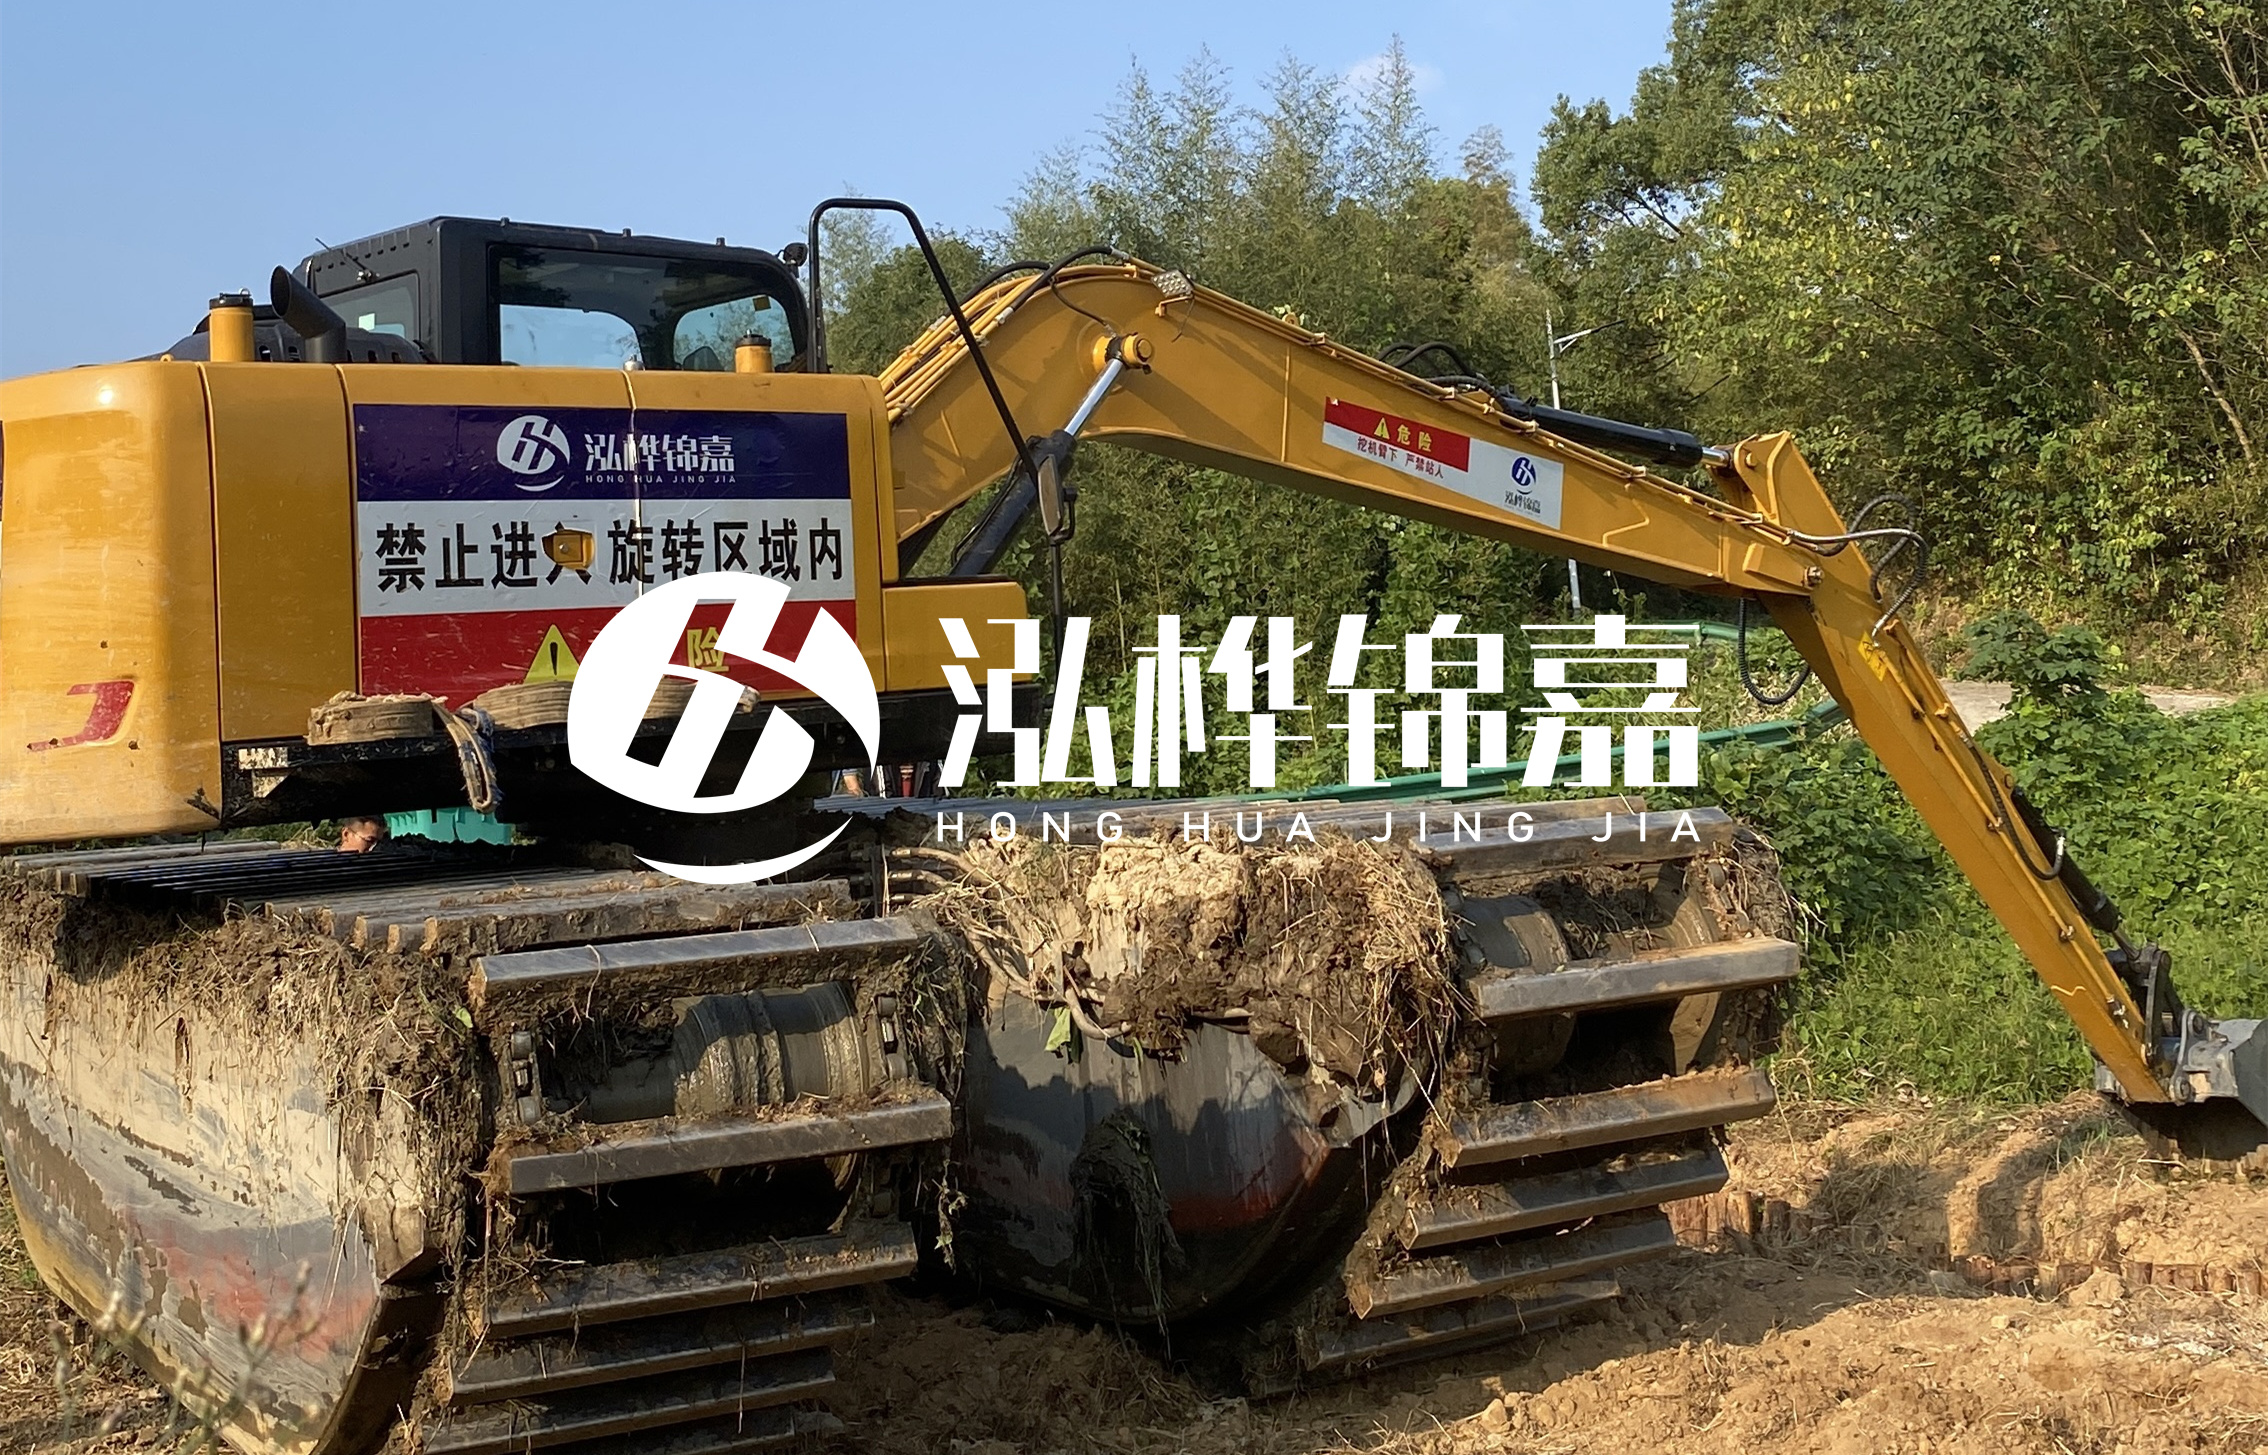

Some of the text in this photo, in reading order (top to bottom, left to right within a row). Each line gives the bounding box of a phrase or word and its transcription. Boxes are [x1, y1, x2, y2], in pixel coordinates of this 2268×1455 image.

[1397, 424, 1432, 452] 危险
[585, 475, 736, 483] HONG HUA JING JIA
[1405, 453, 1444, 479] 严禁站人
